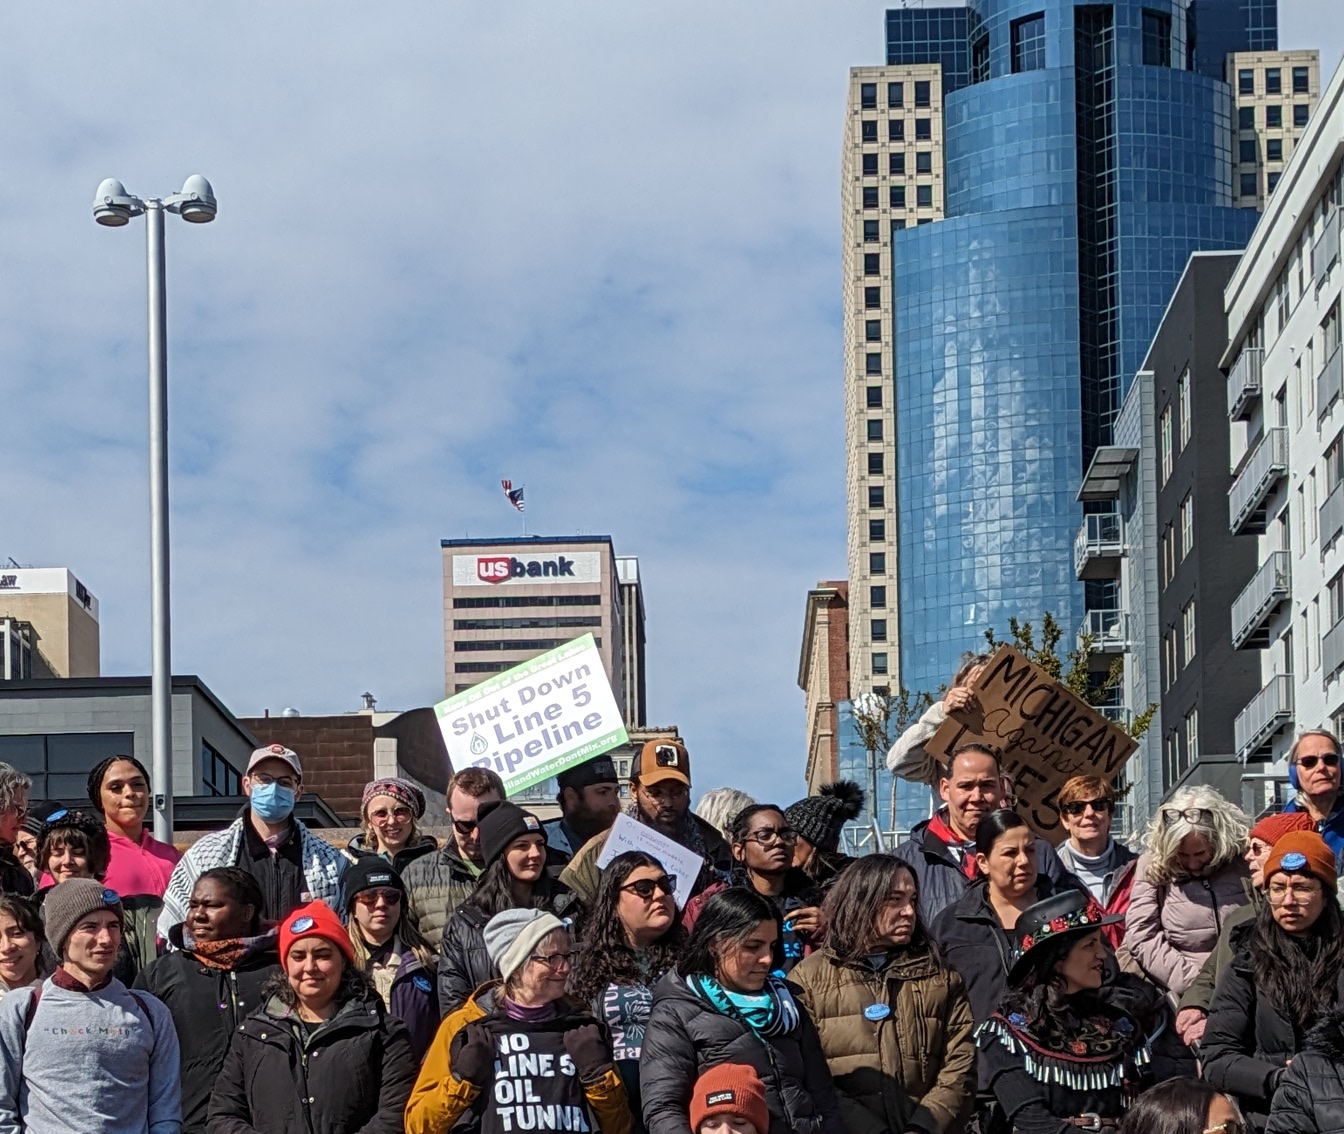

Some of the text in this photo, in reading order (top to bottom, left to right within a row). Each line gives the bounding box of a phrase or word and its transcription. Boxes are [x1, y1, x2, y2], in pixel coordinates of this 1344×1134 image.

[451, 663, 591, 736] Shut Down
[493, 683, 592, 745] Line 5
[980, 654, 1131, 774] MICHIGAN
[497, 1033, 530, 1055] NO
[494, 1053, 576, 1080] LINE 5
[494, 1079, 541, 1104] OIL
